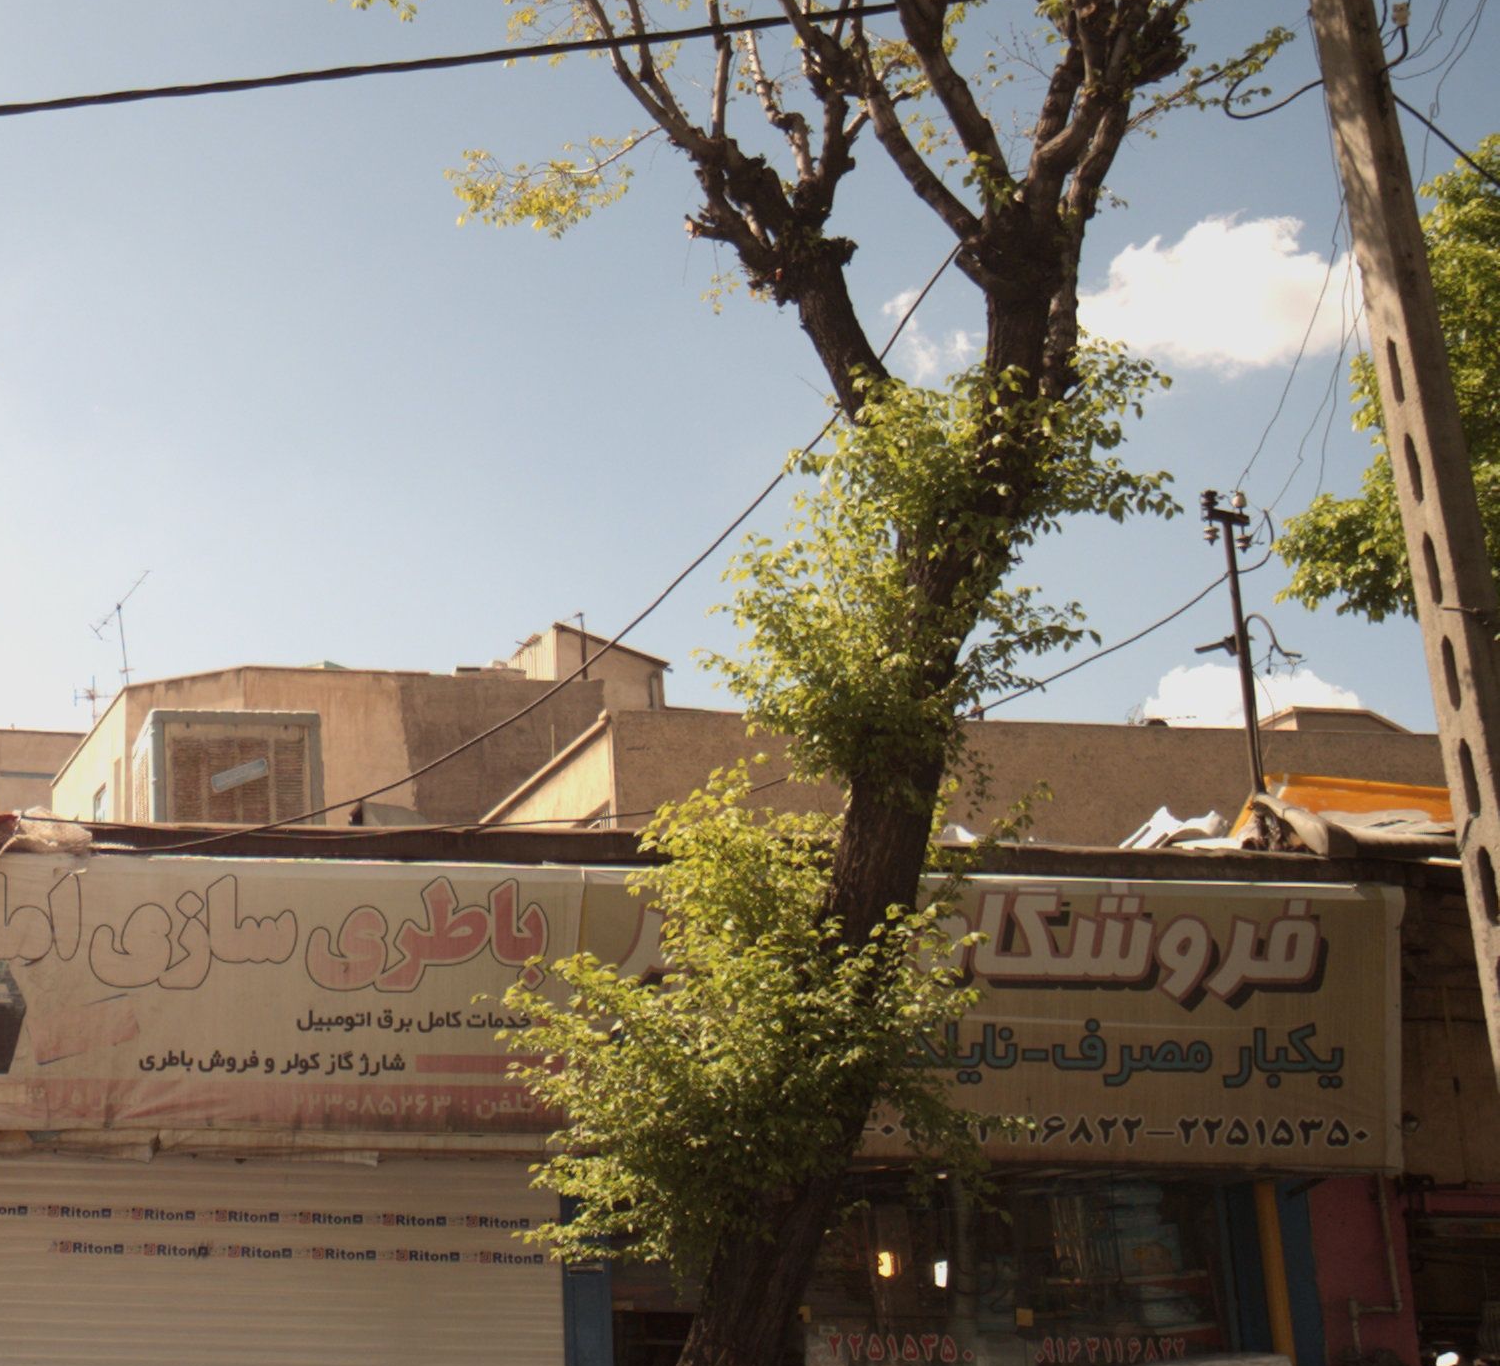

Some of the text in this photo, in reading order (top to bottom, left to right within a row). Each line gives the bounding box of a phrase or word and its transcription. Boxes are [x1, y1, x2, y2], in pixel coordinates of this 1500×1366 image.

[88, 873, 298, 989] سازی
[305, 875, 550, 992] باطری
[296, 1008, 532, 1033] خدمات کامل برق اتومبیل
[138, 1047, 407, 1076] شارژ گاز کولر و فروش باطری
[1222, 1021, 1344, 1089] یکبار
[59, 1205, 100, 1220] Riton
[143, 1208, 184, 1222] Riton
[227, 1210, 269, 1224] Riton
[312, 1212, 353, 1225] Riton
[396, 1214, 437, 1227] Riton
[479, 1215, 519, 1229] Riton
[72, 1241, 534, 1265] Riton Riton Riton Riton Riton Riton
